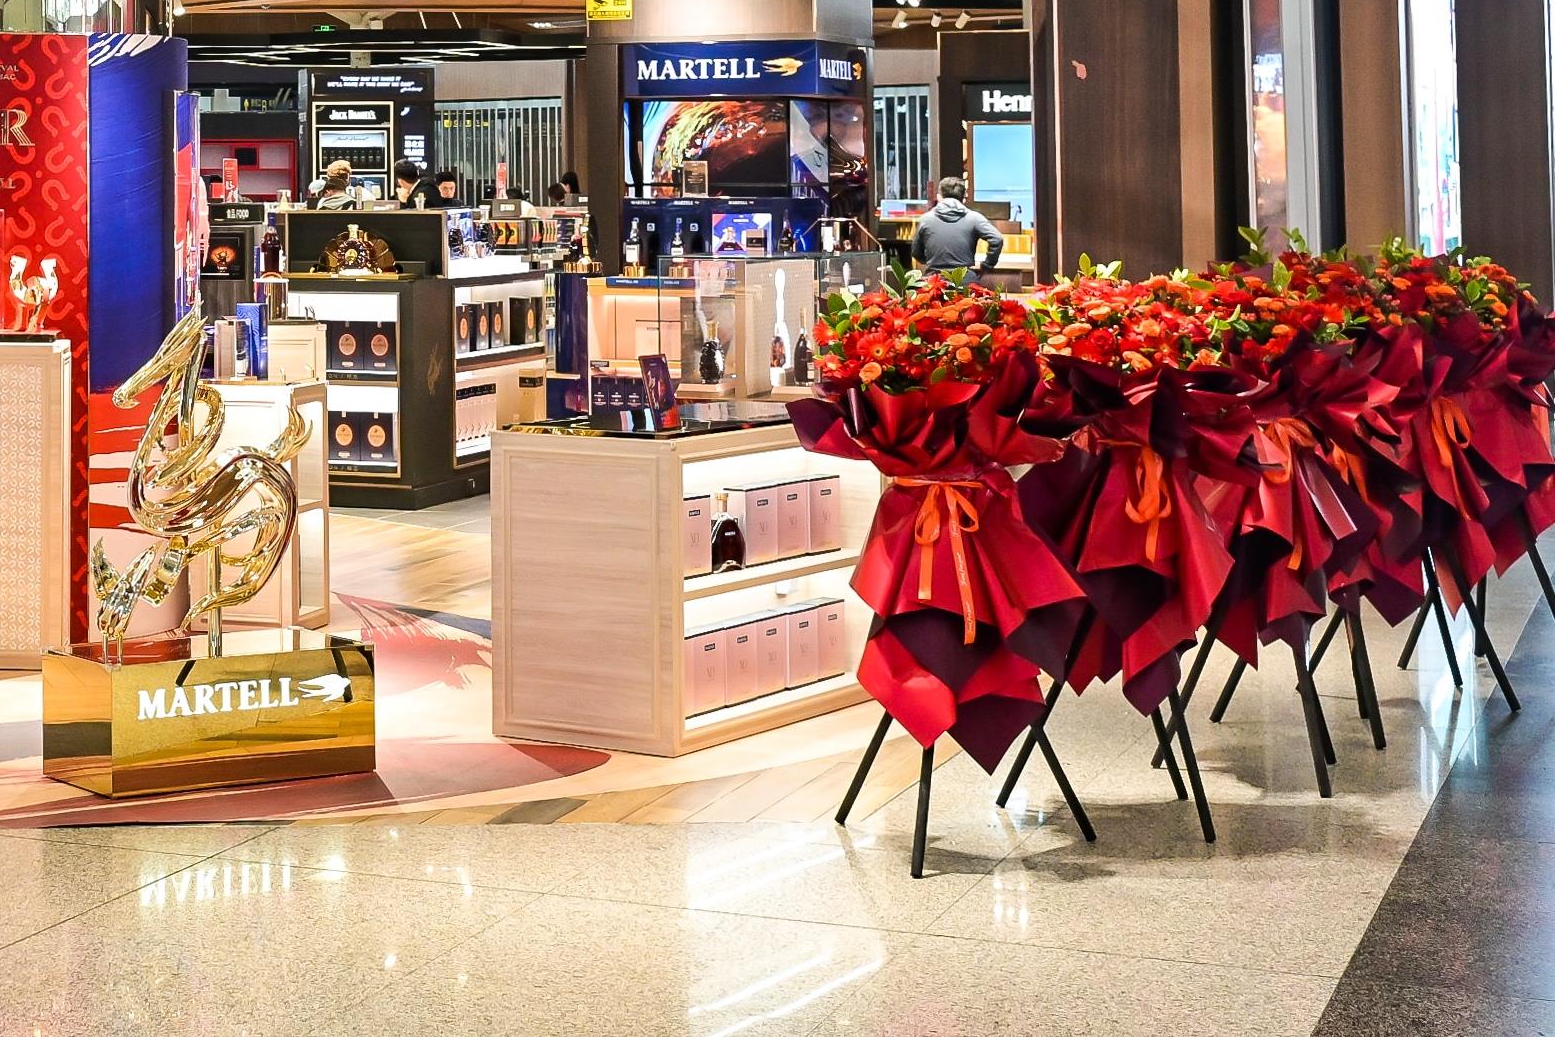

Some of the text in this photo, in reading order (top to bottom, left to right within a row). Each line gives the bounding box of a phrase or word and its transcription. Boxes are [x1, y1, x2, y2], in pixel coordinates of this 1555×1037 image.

[637, 58, 760, 81] MARTELL
[819, 57, 852, 81] MARTELL
[137, 677, 298, 720] MARTELL
